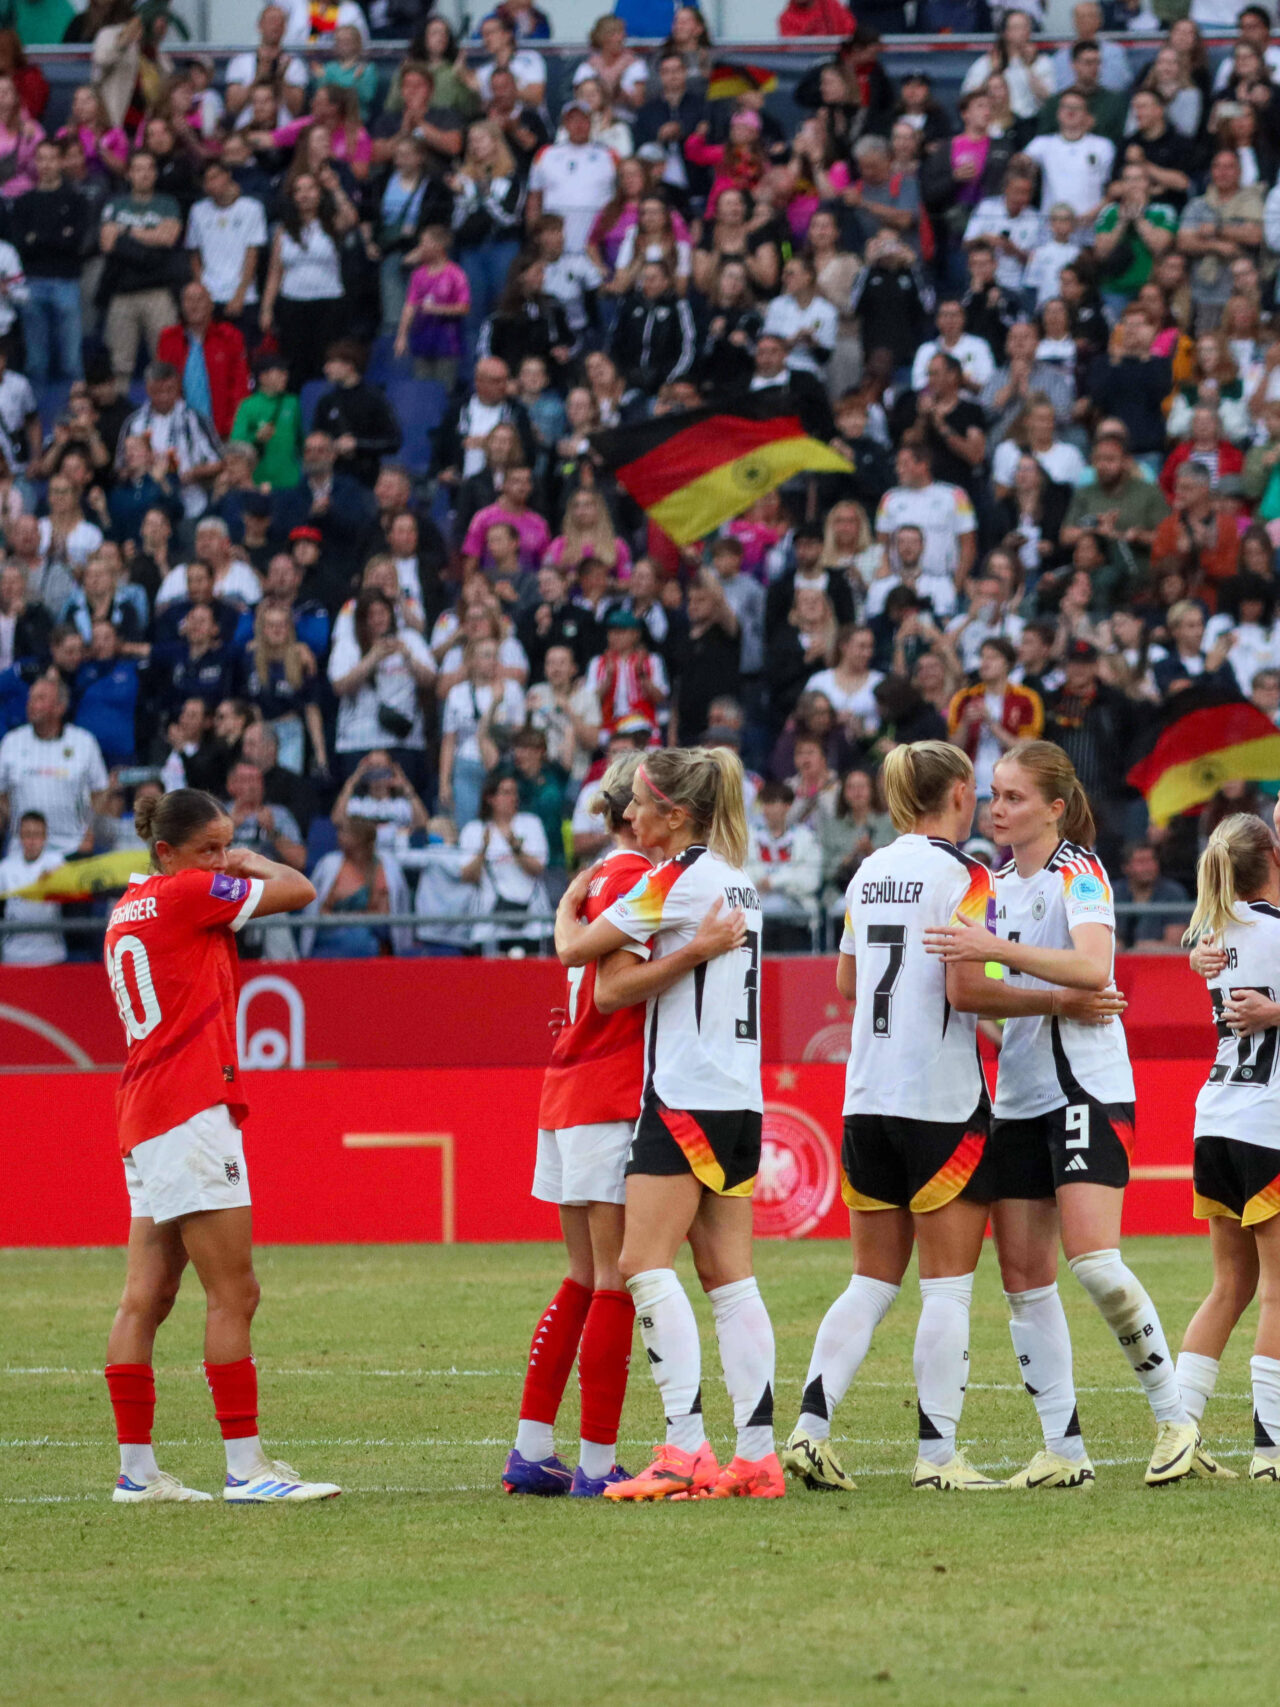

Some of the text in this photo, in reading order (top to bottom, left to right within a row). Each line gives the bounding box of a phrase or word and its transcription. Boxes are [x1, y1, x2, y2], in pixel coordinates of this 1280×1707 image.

[861, 875, 924, 904] SCHÜLLER
[735, 929, 760, 1045] 3
[867, 924, 908, 1038] 7
[1065, 1104, 1089, 1149] 9
[1118, 1323, 1155, 1346] DFB
